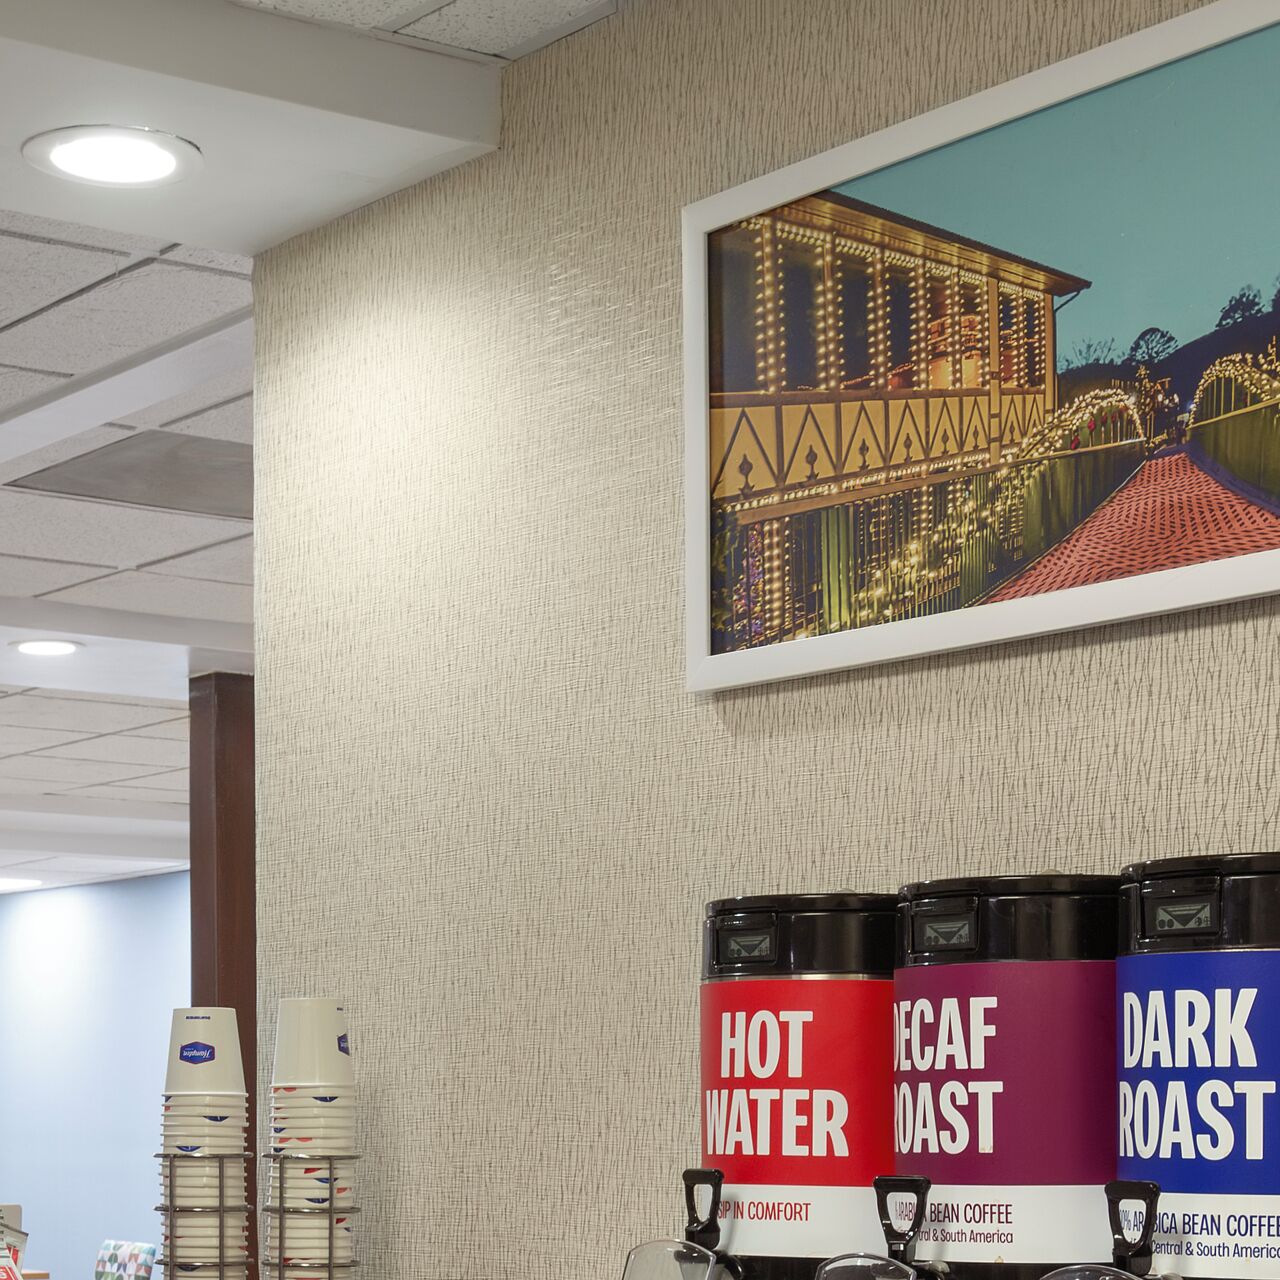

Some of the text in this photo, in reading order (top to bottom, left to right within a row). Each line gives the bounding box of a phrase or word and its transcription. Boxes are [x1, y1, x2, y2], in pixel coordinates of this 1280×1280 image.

[1123, 988, 1258, 1069] DARK
[720, 1010, 814, 1079] HOT
[705, 1088, 850, 1157] WATER
[1119, 1079, 1276, 1161] ROAST
[733, 1200, 744, 1220] IN
[747, 1201, 812, 1222] COMFORT
[929, 1203, 960, 1223] BEAN
[963, 1204, 1013, 1224] COFFEE
[1182, 1213, 1221, 1236] BEAN
[932, 1230, 939, 1242] &
[940, 1229, 967, 1243] South
[969, 1230, 1014, 1244] America
[1185, 1242, 1194, 1256] &
[1196, 1242, 1230, 1258] South
